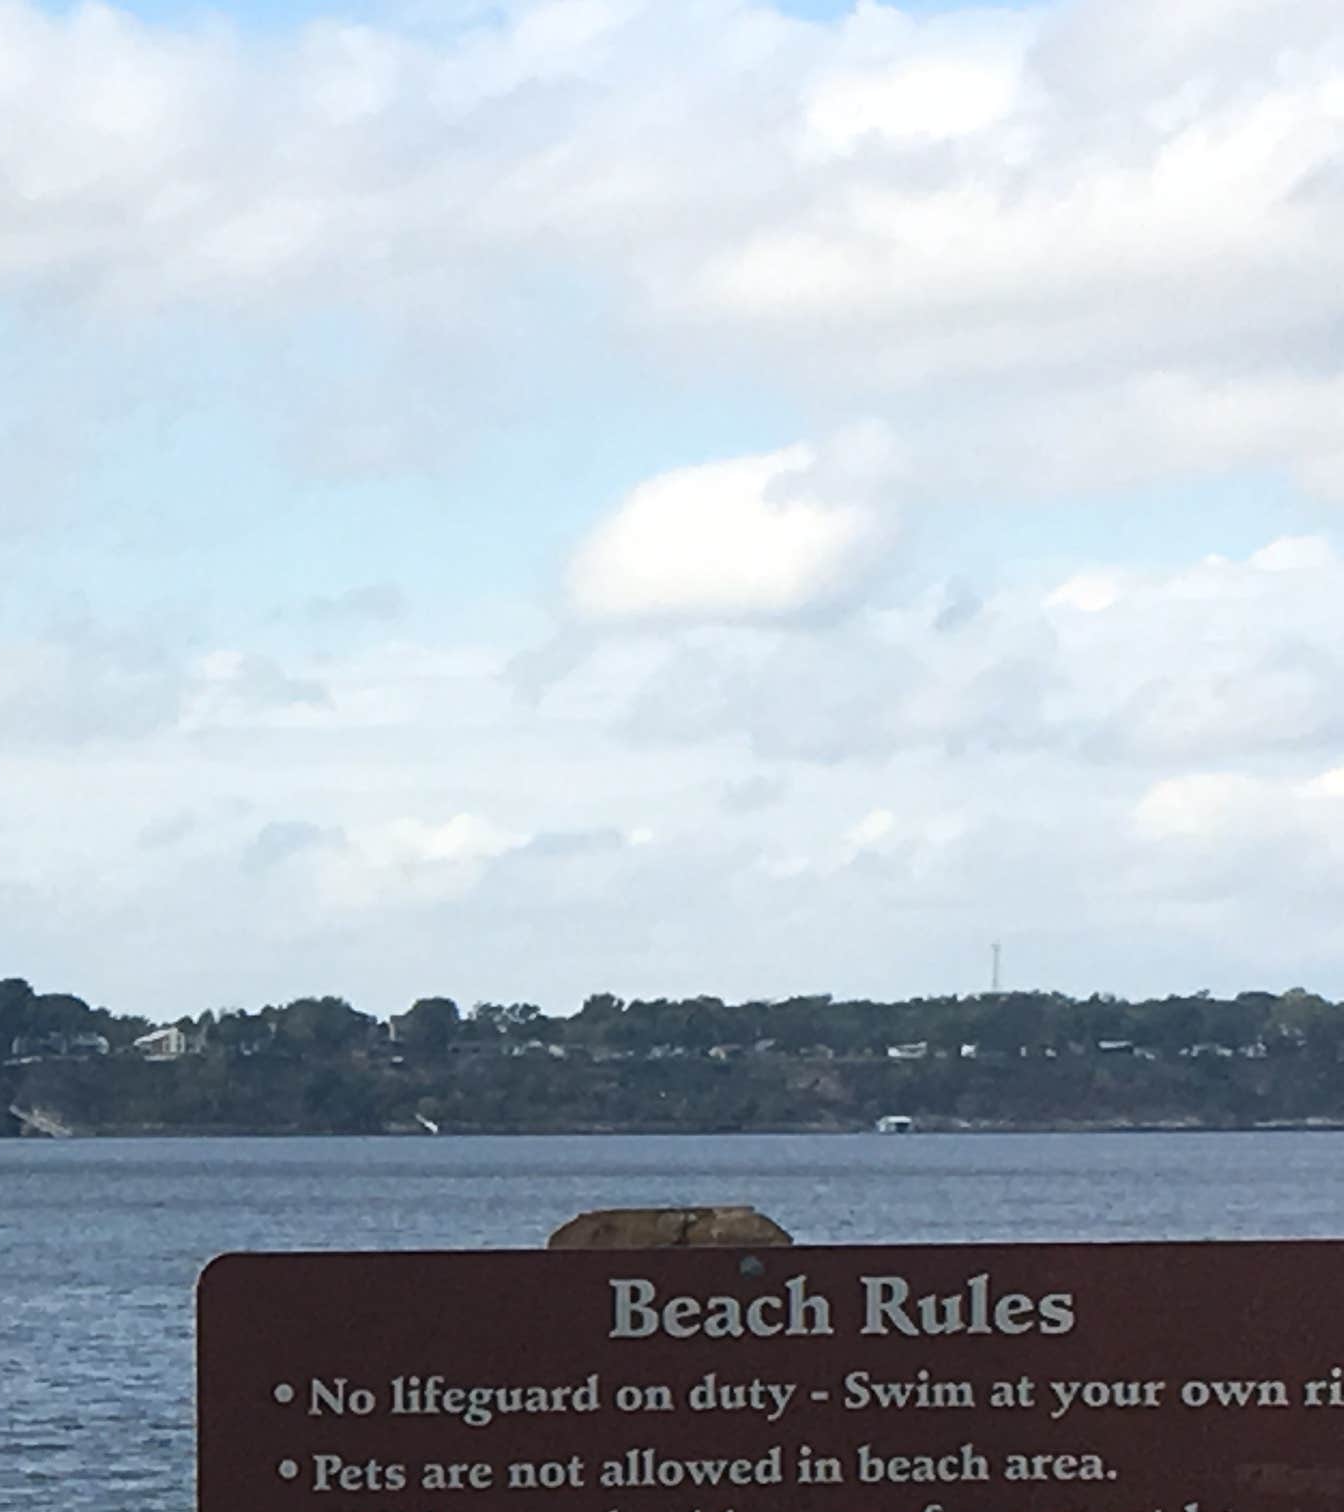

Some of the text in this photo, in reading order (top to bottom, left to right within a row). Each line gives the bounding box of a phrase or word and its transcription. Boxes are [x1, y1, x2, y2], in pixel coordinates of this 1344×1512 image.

[609, 1273, 1074, 1338] Beach Rules
[309, 1378, 375, 1415] No
[391, 1374, 600, 1426] lifeguard
[616, 1386, 674, 1411] on
[690, 1373, 797, 1421] duty
[844, 1369, 975, 1409] Swim
[990, 1376, 1035, 1407] at
[1050, 1381, 1166, 1419] your
[1181, 1380, 1289, 1407] own
[1304, 1367, 1344, 1406] ri
[313, 1443, 1117, 1491] Pets are not allowed in beach area.
